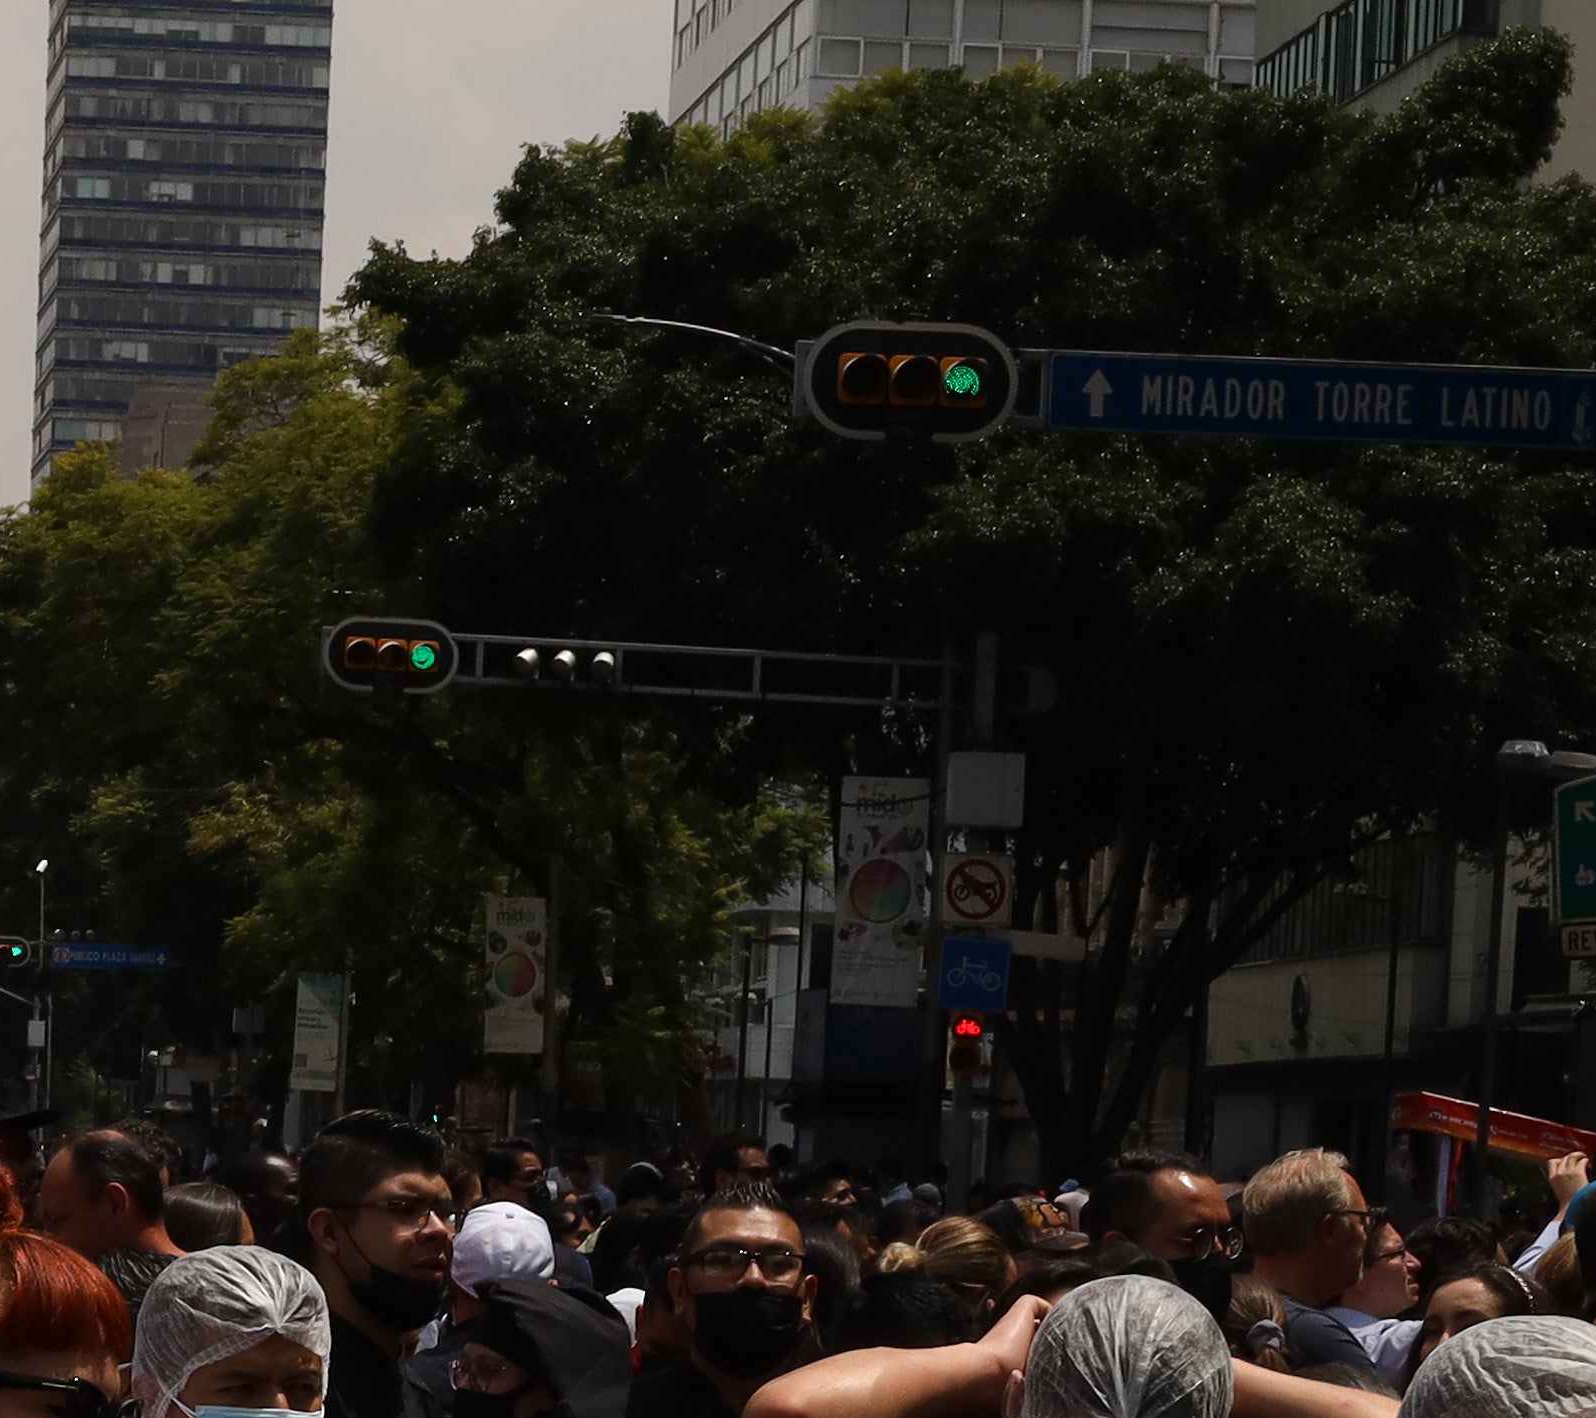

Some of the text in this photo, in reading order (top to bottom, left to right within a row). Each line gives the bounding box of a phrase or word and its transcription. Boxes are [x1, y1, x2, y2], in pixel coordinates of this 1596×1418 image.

[1141, 375, 1552, 431] MIRADOR TORRE LATINO
